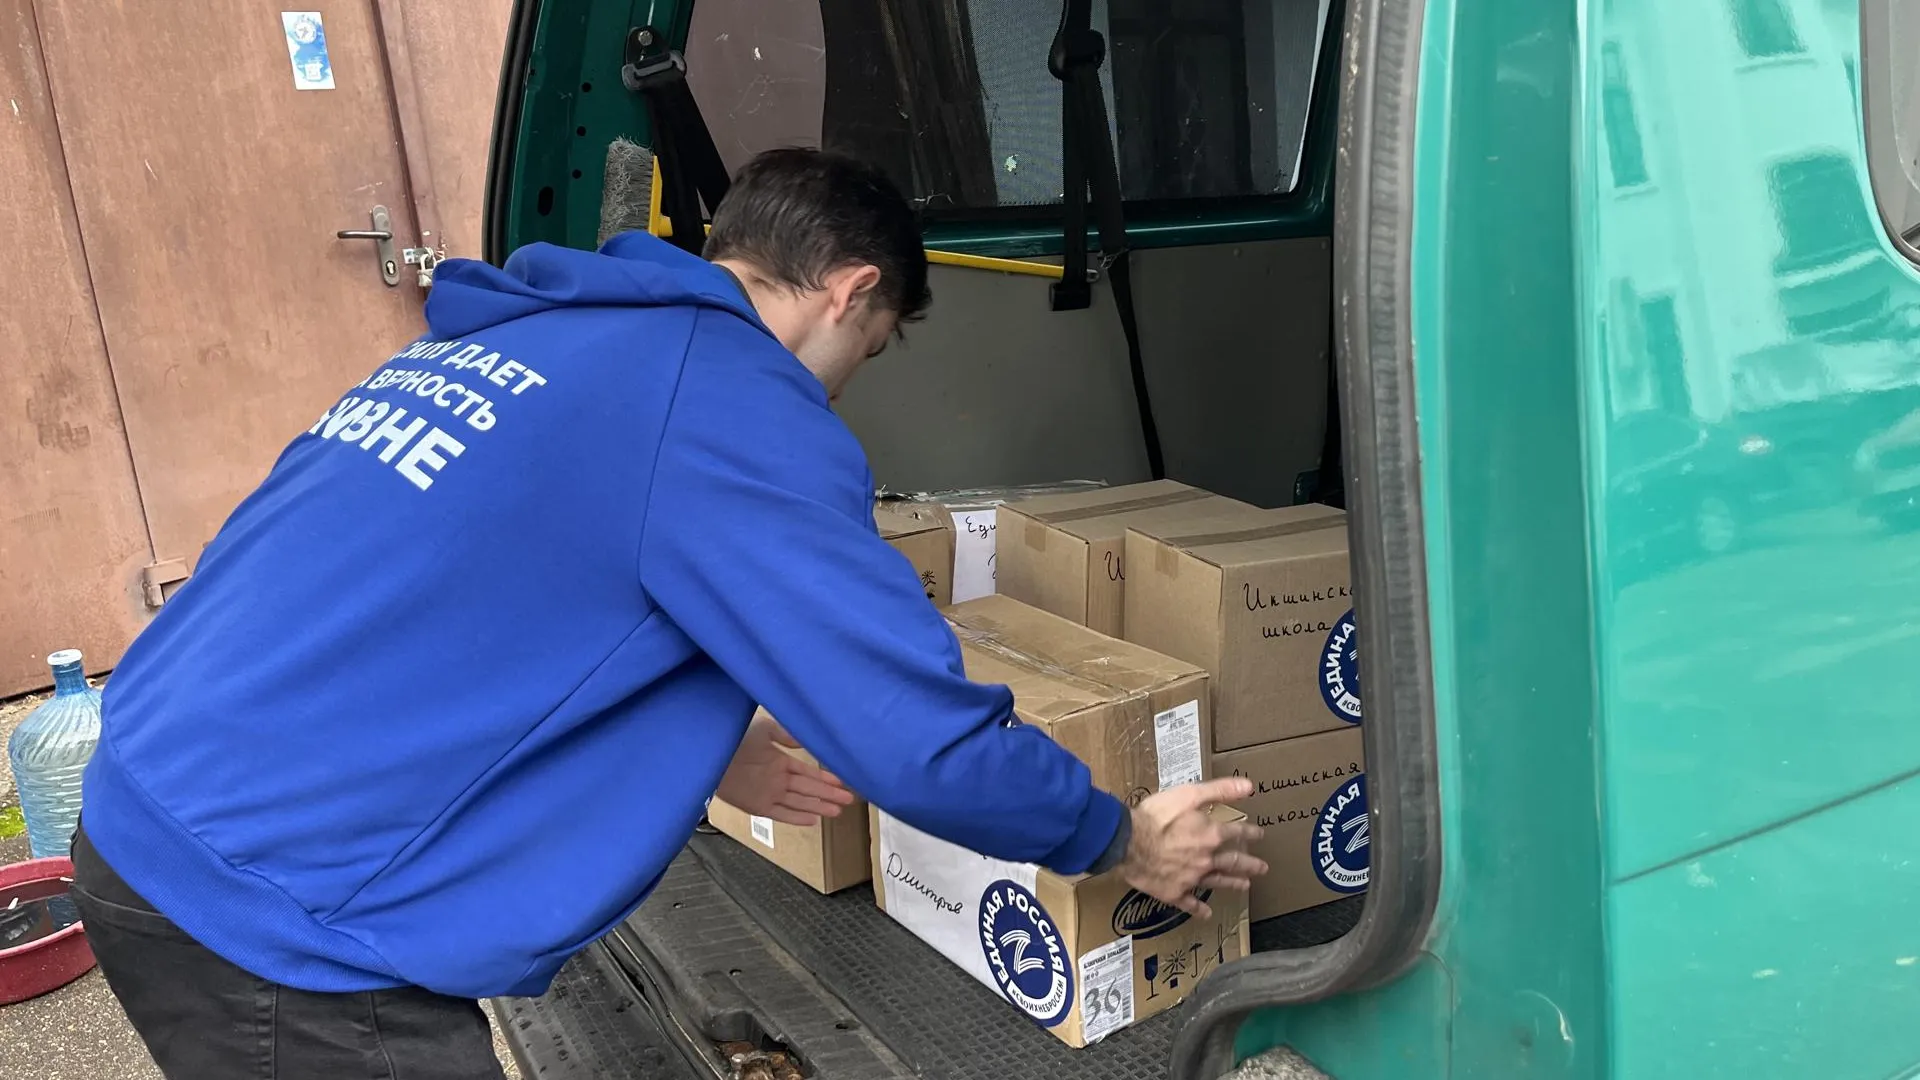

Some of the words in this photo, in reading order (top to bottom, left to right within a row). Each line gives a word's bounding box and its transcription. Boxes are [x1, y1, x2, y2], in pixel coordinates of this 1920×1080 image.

[366, 368, 498, 431] ВЕРНОСТЬ
[441, 343, 548, 396] ДАЕТ
[1262, 621, 1332, 639] школа
[1325, 615, 1356, 699] ЕДИНА
[1256, 806, 1321, 828] школа
[1317, 782, 1361, 869] ЕДИНАЯ
[886, 851, 964, 916] Дмитров
[982, 889, 1010, 985] ЕДИНАЯ
[1006, 887, 1065, 973] РОССИЯ
[1084, 977, 1121, 1027] 36
